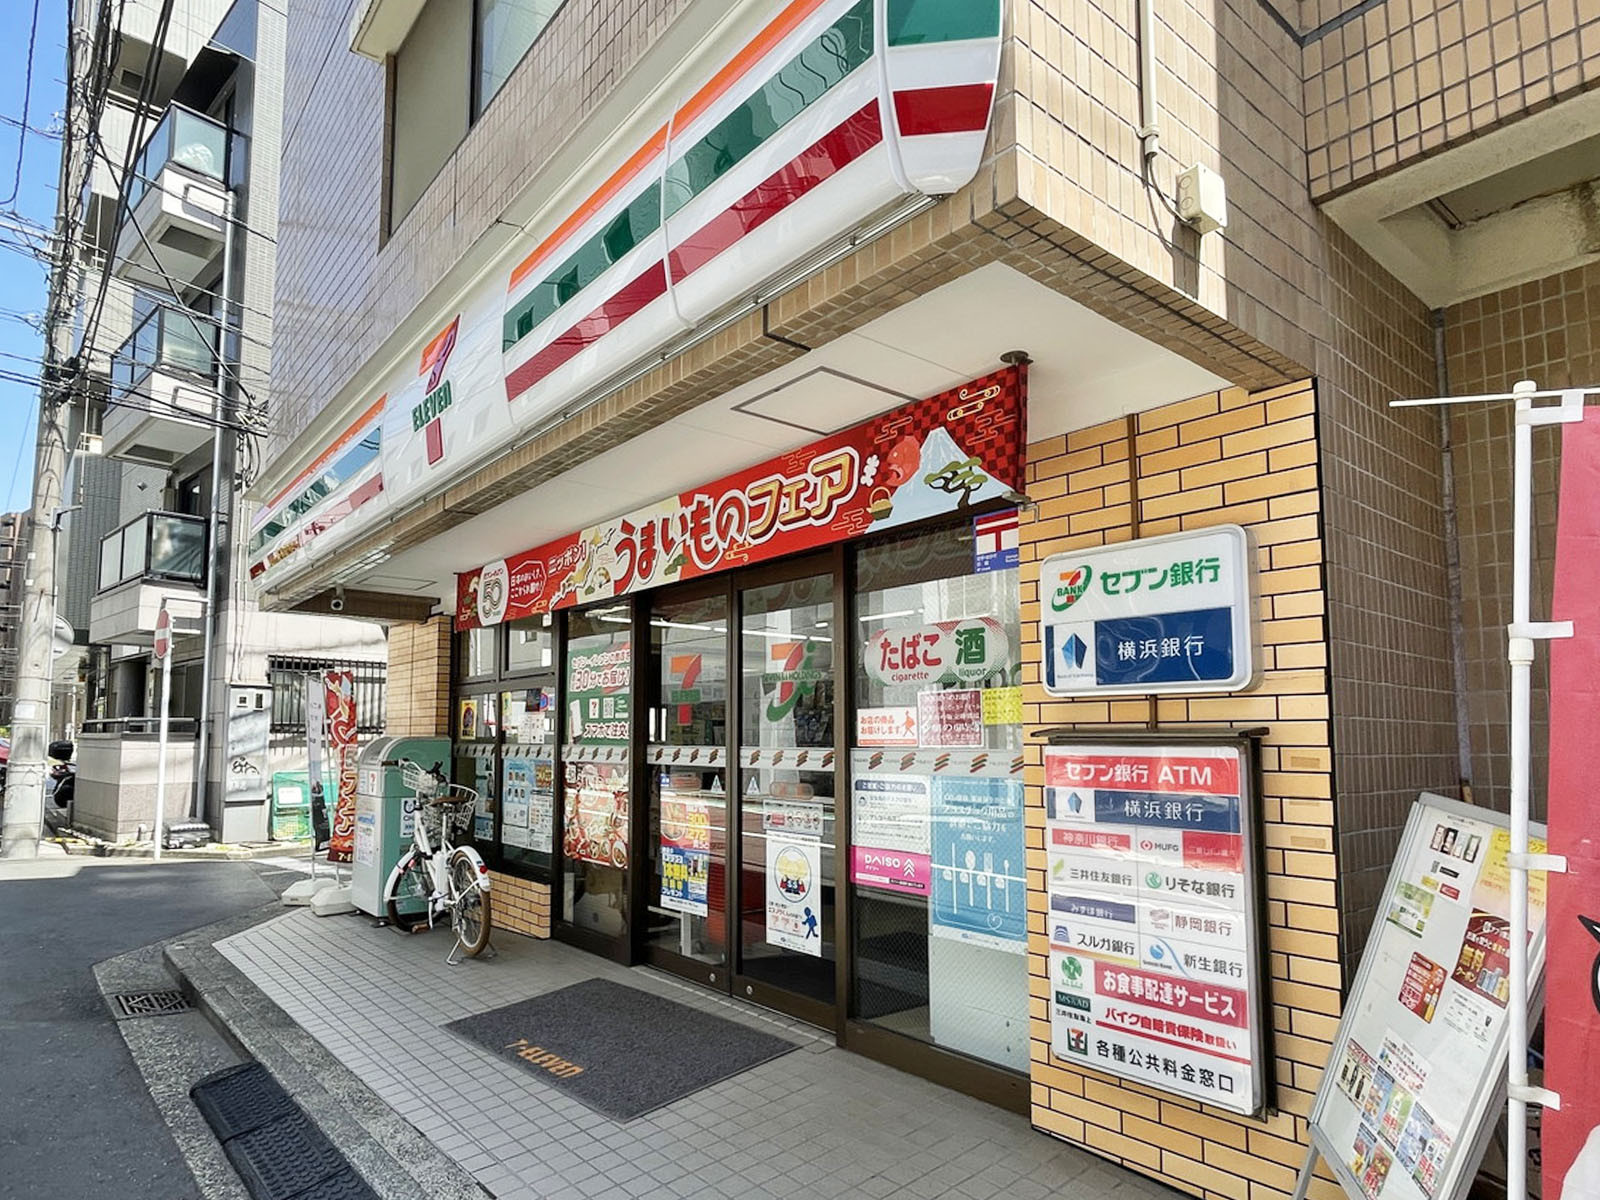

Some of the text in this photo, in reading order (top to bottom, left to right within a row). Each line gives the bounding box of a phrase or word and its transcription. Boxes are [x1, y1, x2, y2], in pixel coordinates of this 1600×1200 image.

[612, 450, 856, 597] うまいものフェア
[1100, 557, 1220, 596] セブン銀行
[1057, 586, 1084, 597] BANK
[880, 632, 942, 671] たばこ
[955, 627, 986, 666] 酒
[1117, 635, 1204, 661] 横浜銀行
[891, 671, 929, 682] cigarette
[958, 667, 987, 679] liquor
[1064, 762, 1212, 786] セブン銀行 ATM
[1124, 801, 1204, 822] 横浜銀行
[1062, 831, 1118, 847] 神奈川銀行
[1154, 842, 1179, 852] MUFG
[864, 854, 901, 868] DAISO
[1069, 868, 1132, 887] 三井住友銀行
[1165, 876, 1235, 899] りそな銀行
[1070, 903, 1113, 919] みずほ銀行
[1174, 915, 1232, 936] 静岡銀行
[1077, 933, 1135, 956] スルガ銀行
[1183, 953, 1243, 978] 新生銀行
[1103, 970, 1237, 1019] お食事配達サービス
[1105, 1007, 1237, 1050] バイク自賠責保険取扱い
[1096, 1039, 1234, 1094] 各種公共料金窓口
